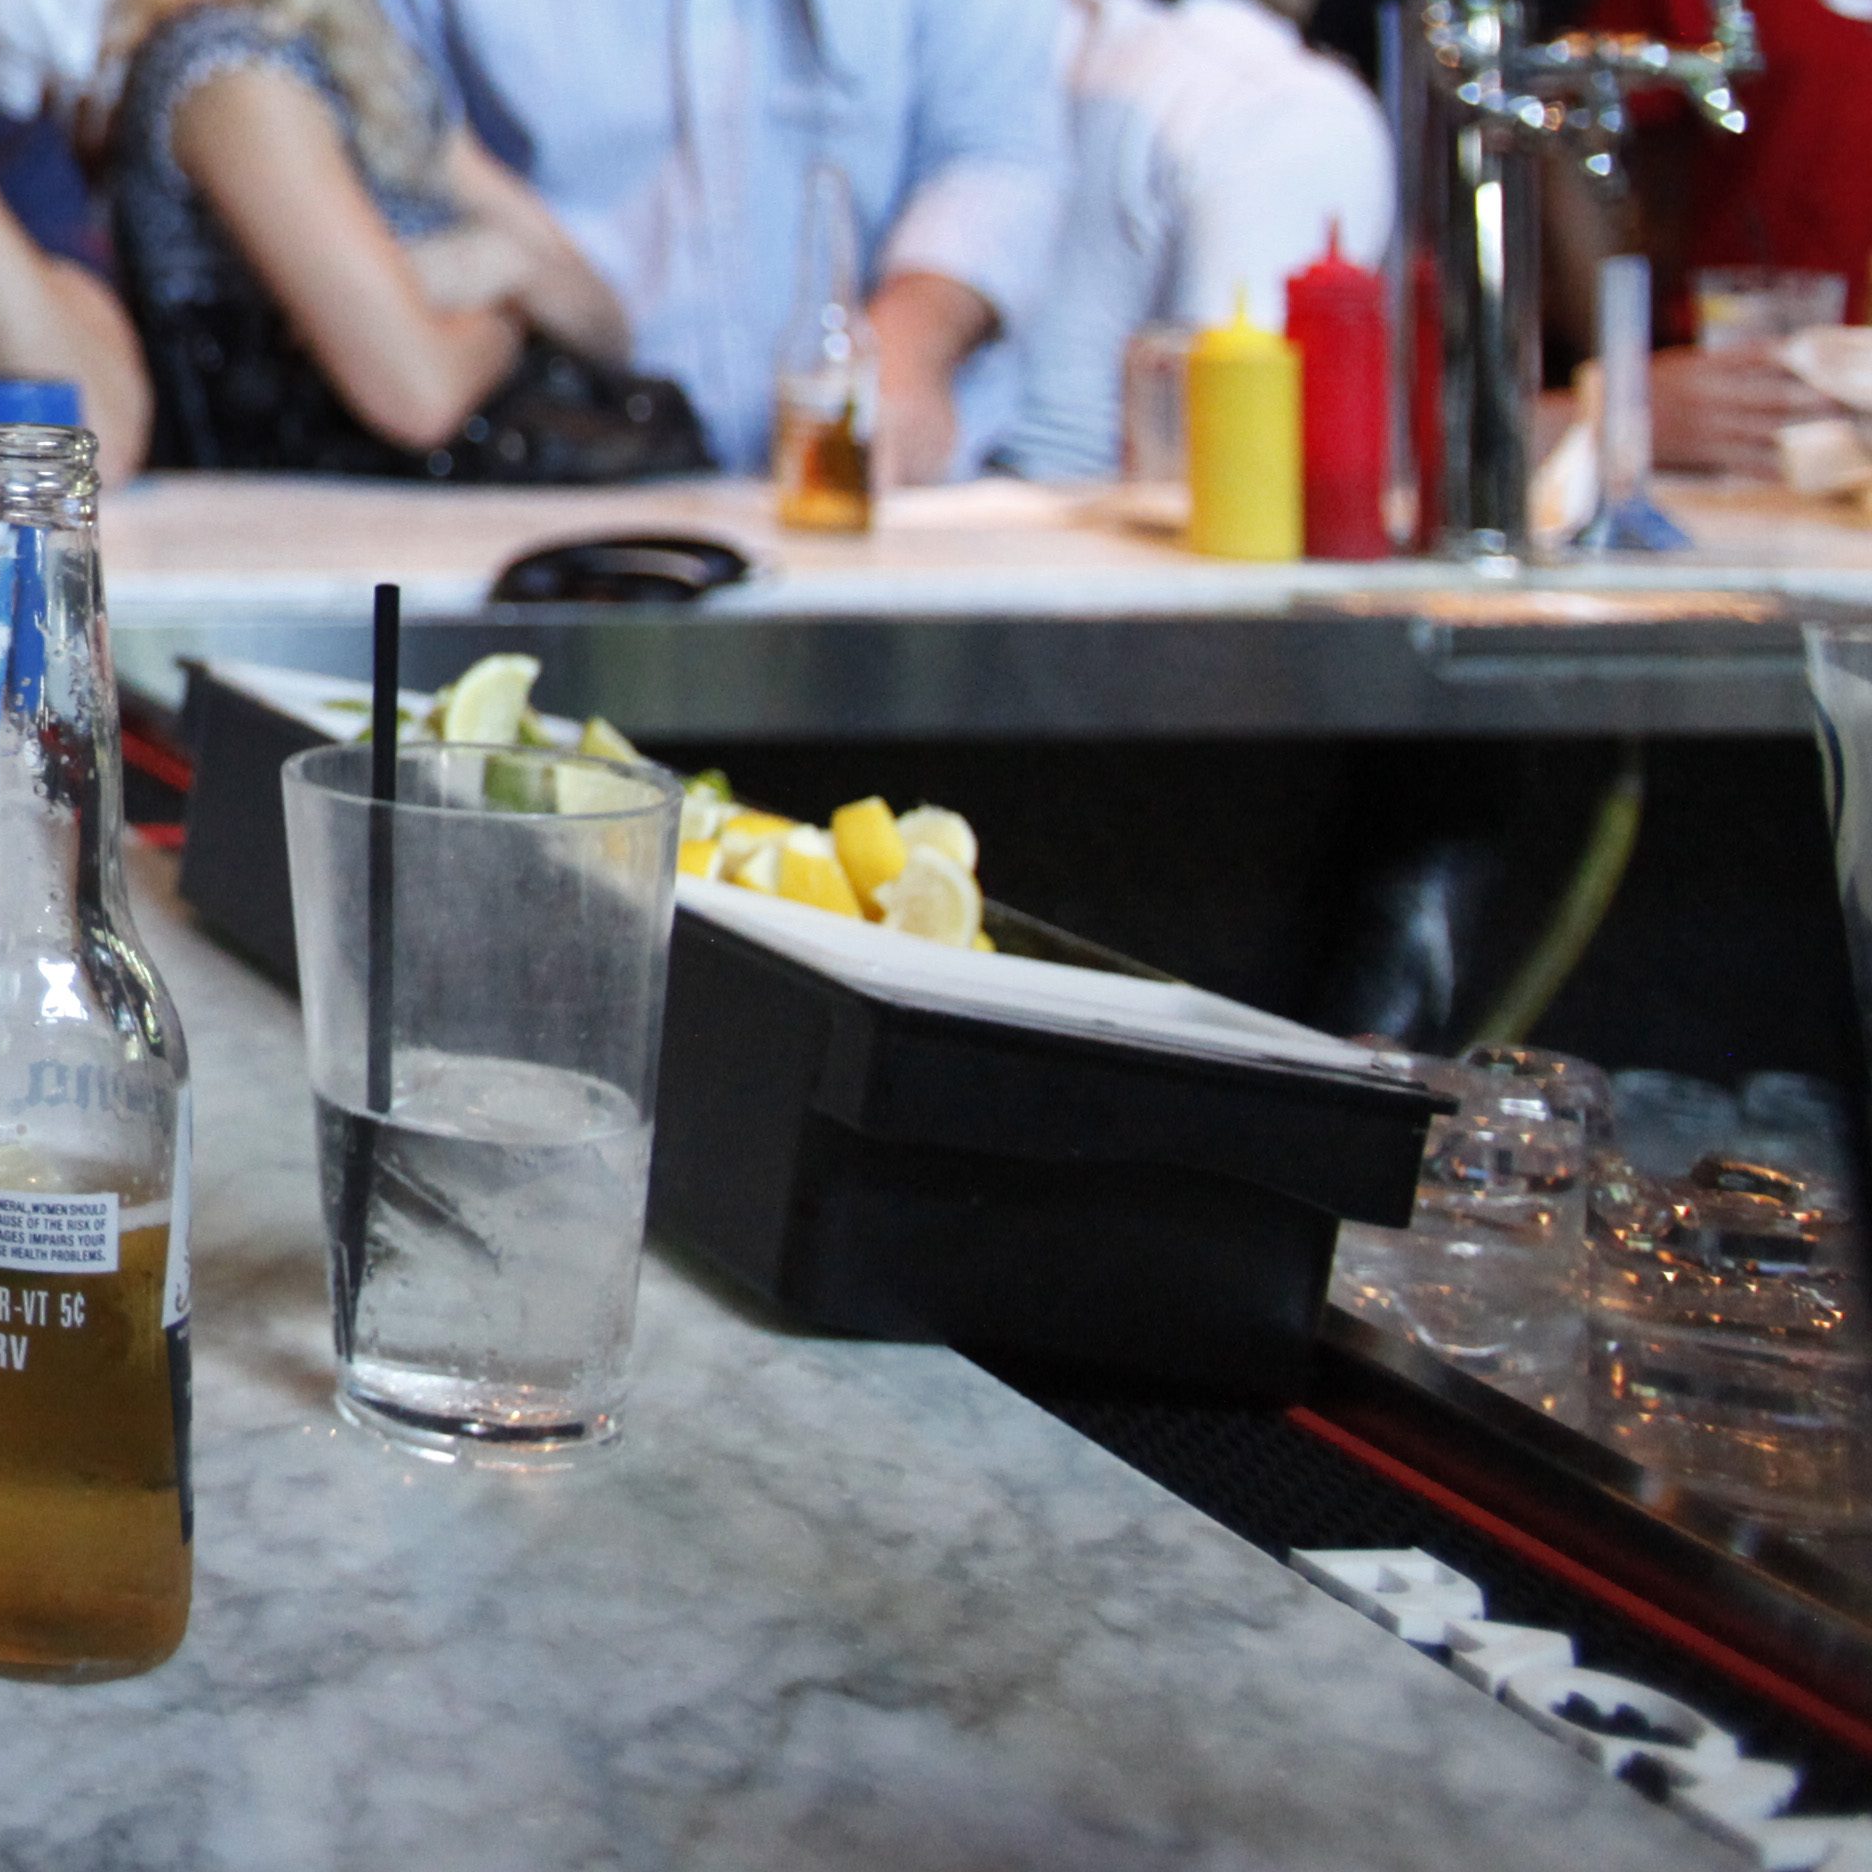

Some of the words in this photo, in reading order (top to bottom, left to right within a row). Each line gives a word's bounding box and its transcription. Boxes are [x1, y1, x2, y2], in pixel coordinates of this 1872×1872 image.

[32, 1203, 67, 1216] WOMEN
[69, 1203, 108, 1216] SHOULD
[27, 1217, 39, 1229] OF
[44, 1218, 63, 1231] THE
[67, 1219, 91, 1231] RISK
[94, 1219, 106, 1231] OF
[29, 1233, 74, 1247] IMPAIRS
[78, 1234, 106, 1247] YOUR
[11, 1246, 48, 1260] HEALTH
[50, 1249, 106, 1262] PROBLEMS.
[60, 1292, 86, 1328] 5¢
